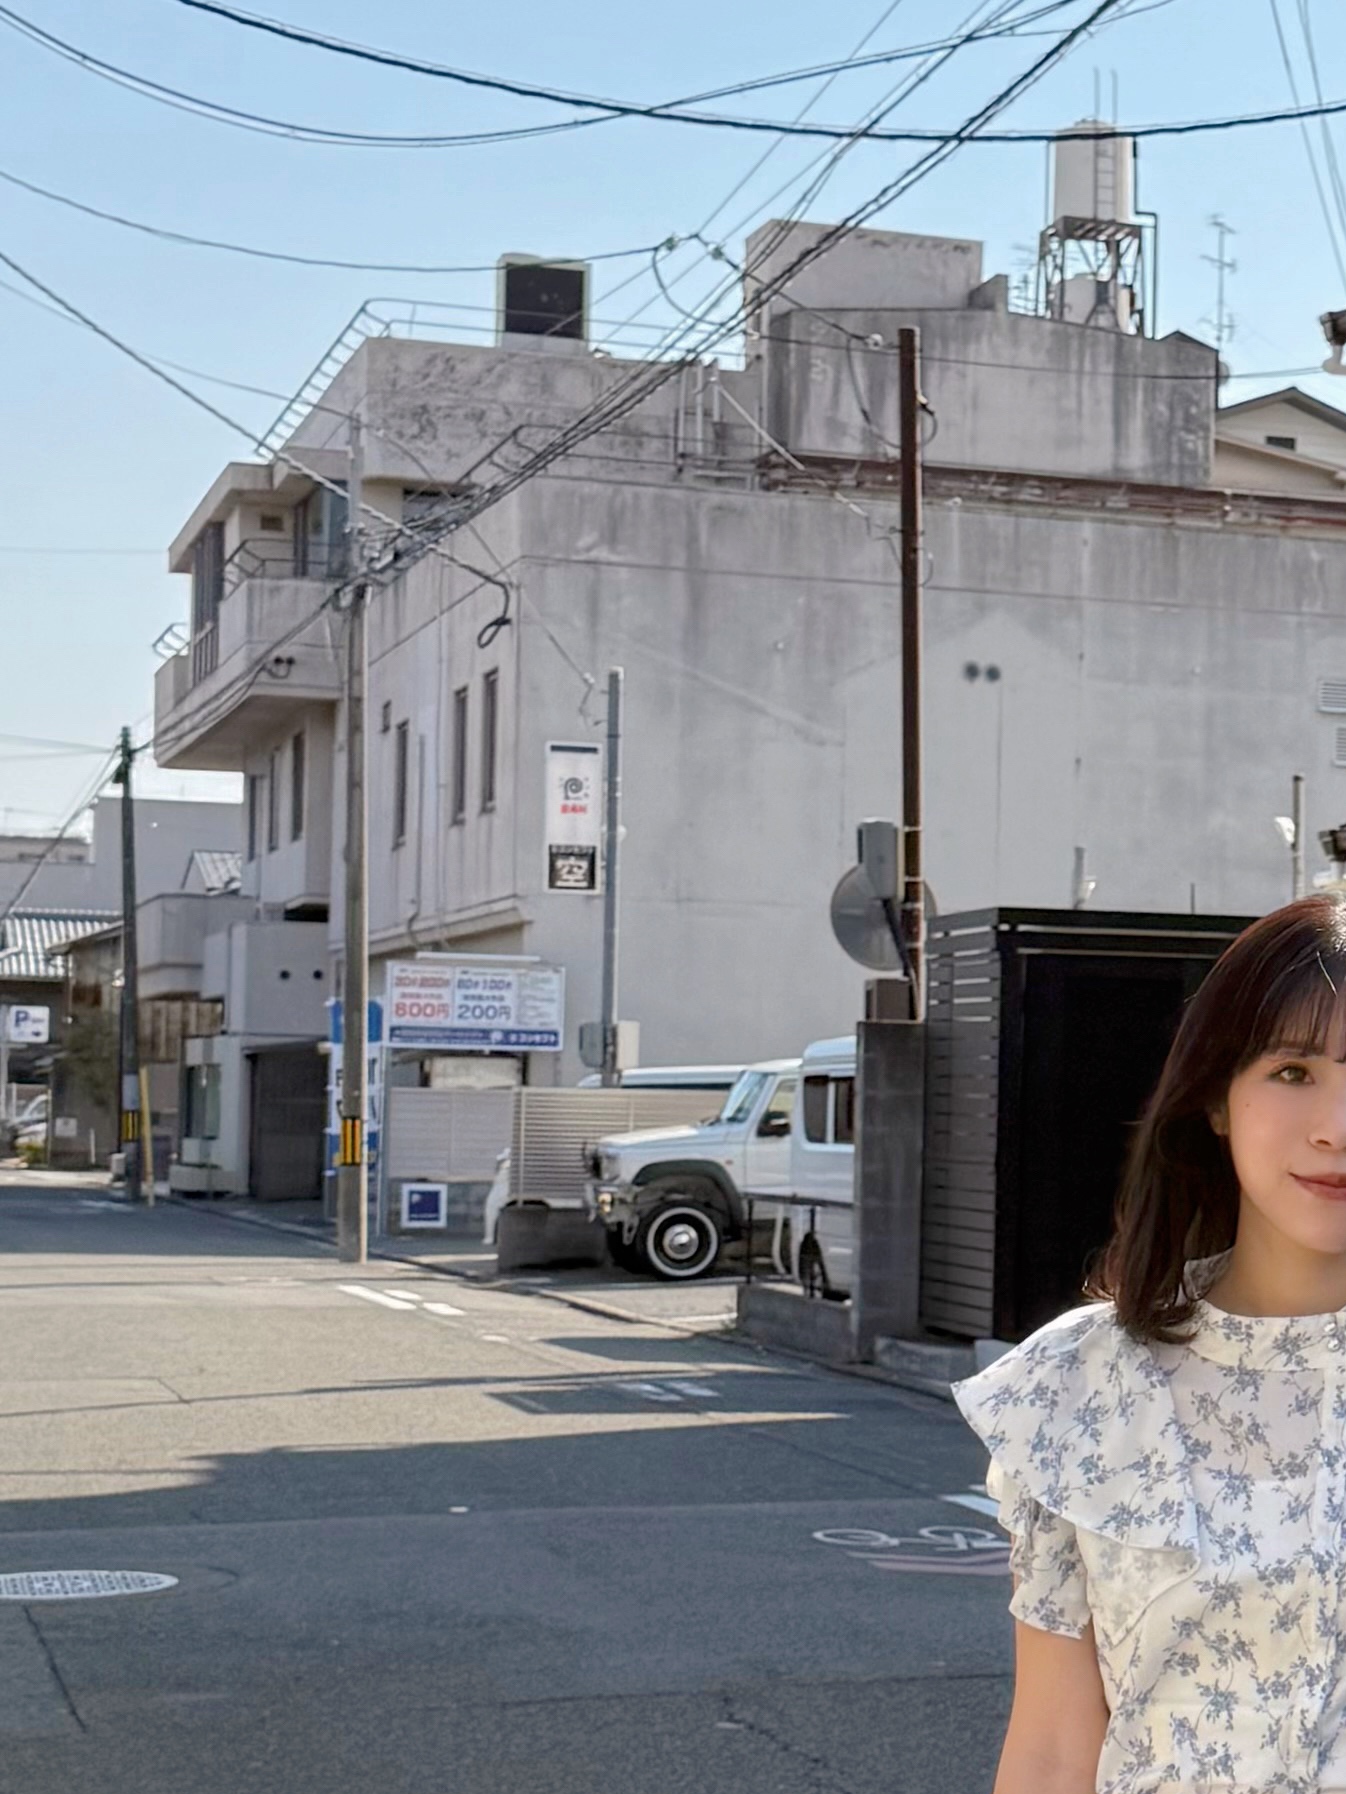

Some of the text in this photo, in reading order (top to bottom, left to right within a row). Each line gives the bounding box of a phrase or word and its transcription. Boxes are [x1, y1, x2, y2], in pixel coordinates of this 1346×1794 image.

[555, 855, 589, 887] 空
[15, 1010, 30, 1027] P
[458, 1004, 511, 1021] 200円
